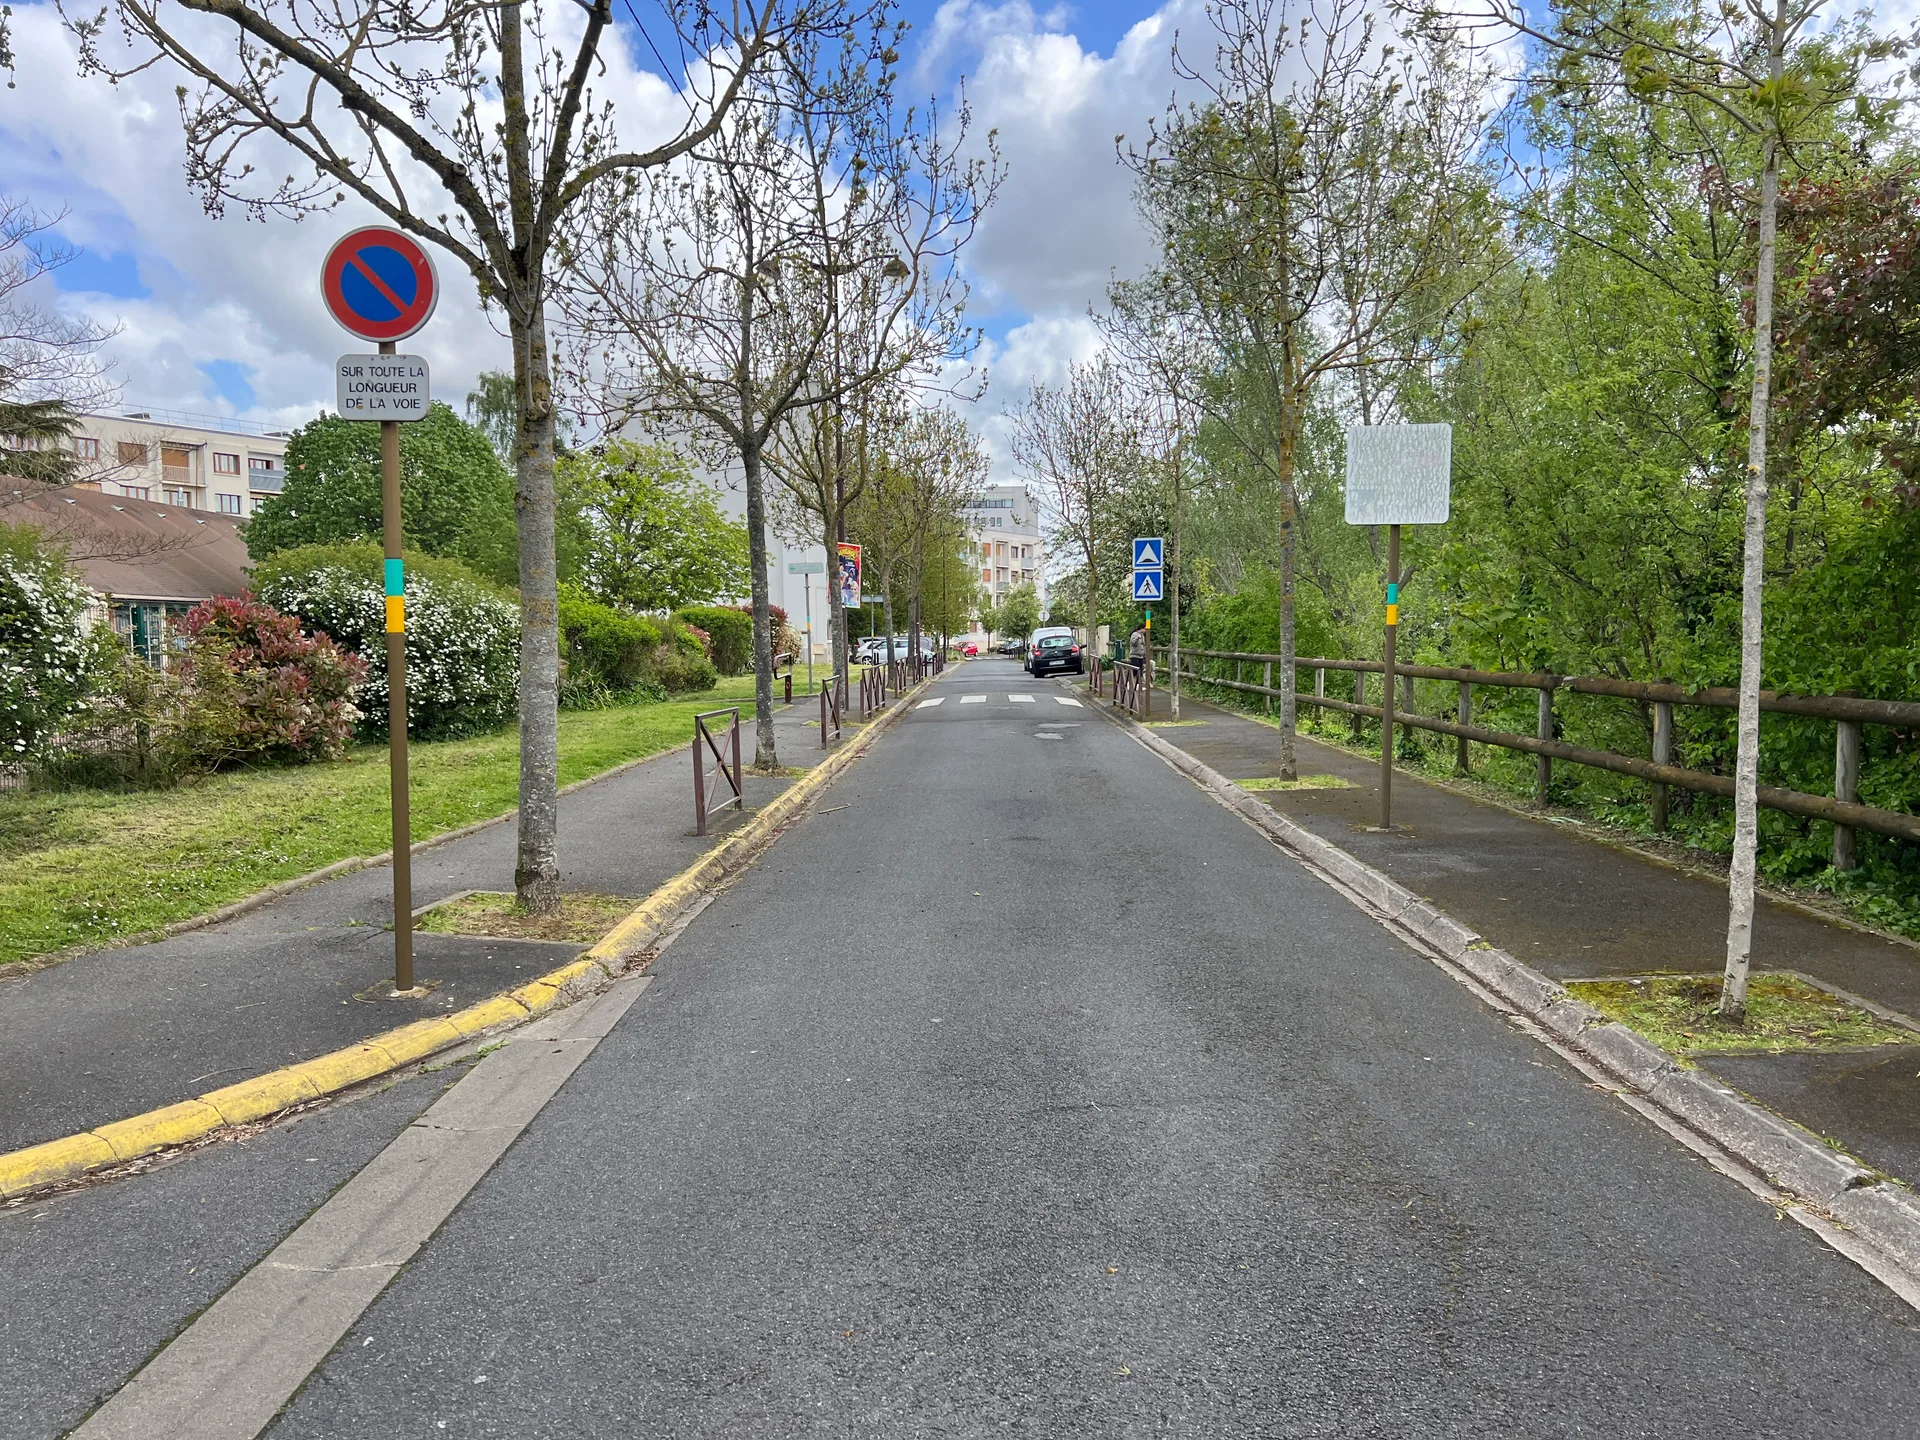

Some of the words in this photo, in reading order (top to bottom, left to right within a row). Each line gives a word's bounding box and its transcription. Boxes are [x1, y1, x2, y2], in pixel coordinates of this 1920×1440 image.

[341, 366, 363, 377] SUR
[368, 366, 405, 377] TOUTE
[409, 367, 424, 377] LA
[349, 382, 417, 393] LONGUEUR
[346, 398, 364, 409] DE
[369, 398, 386, 409] LA
[392, 398, 421, 409] VOIE
